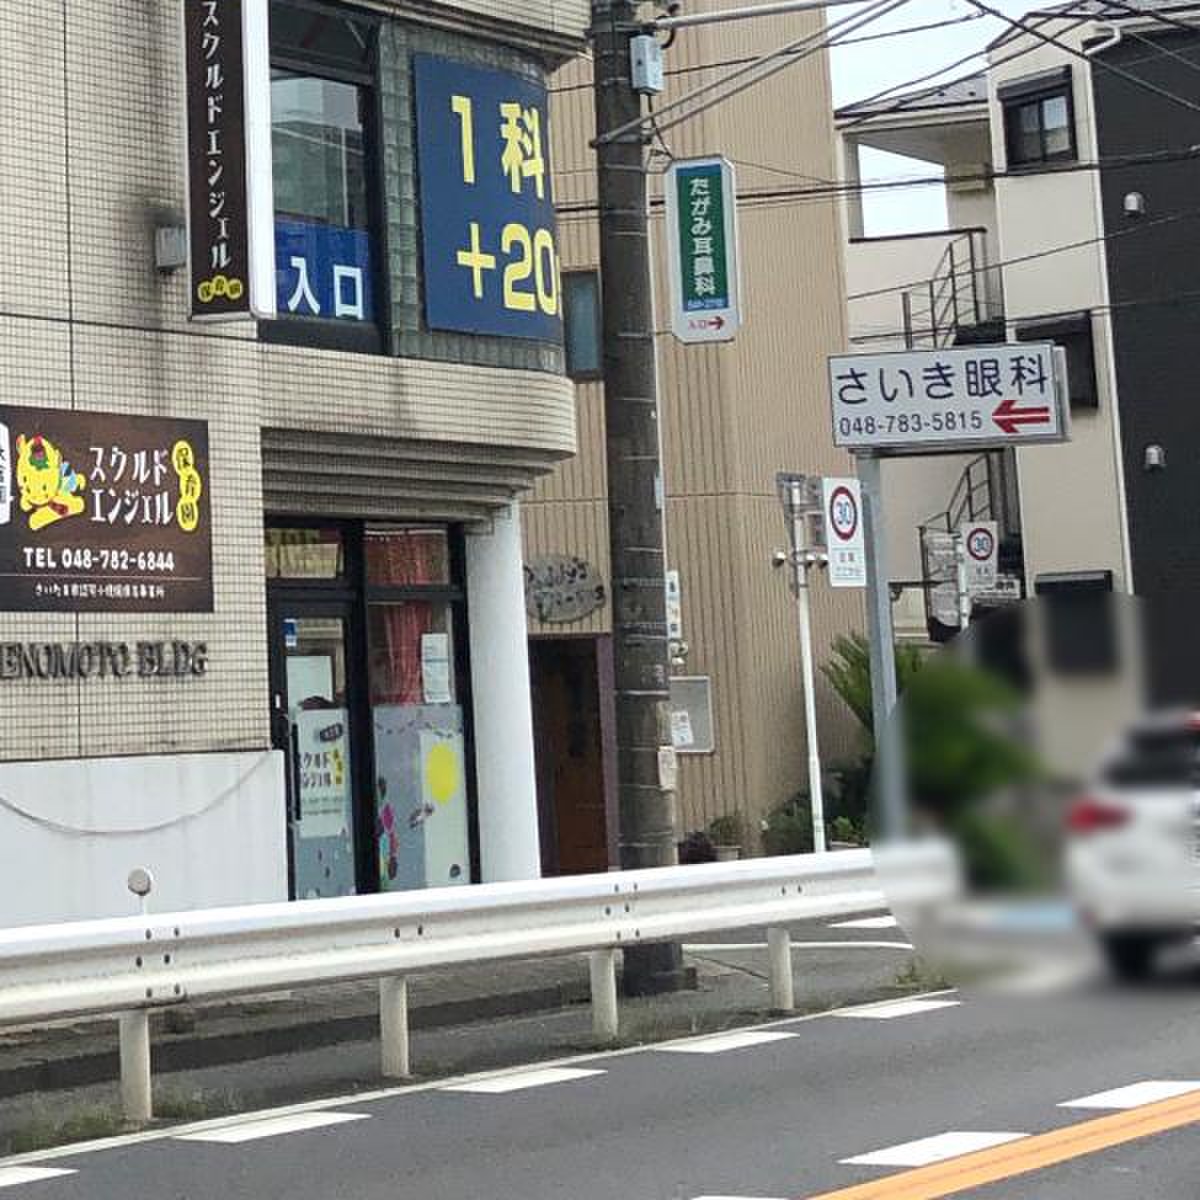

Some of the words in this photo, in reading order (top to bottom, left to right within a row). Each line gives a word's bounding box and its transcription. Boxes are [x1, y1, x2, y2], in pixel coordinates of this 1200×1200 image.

[201, 0, 232, 270] スクルドエンジェル
[287, 255, 364, 320] 入口
[835, 353, 1049, 406] さいき眼科
[839, 409, 983, 438] 048-783-5815
[89, 445, 169, 486] スクルド
[91, 488, 174, 526] エンジェル
[835, 501, 852, 525] 30
[23, 547, 57, 569] TEL
[62, 548, 176, 572] 048-782-6844
[137, 640, 208, 679] BLDG
